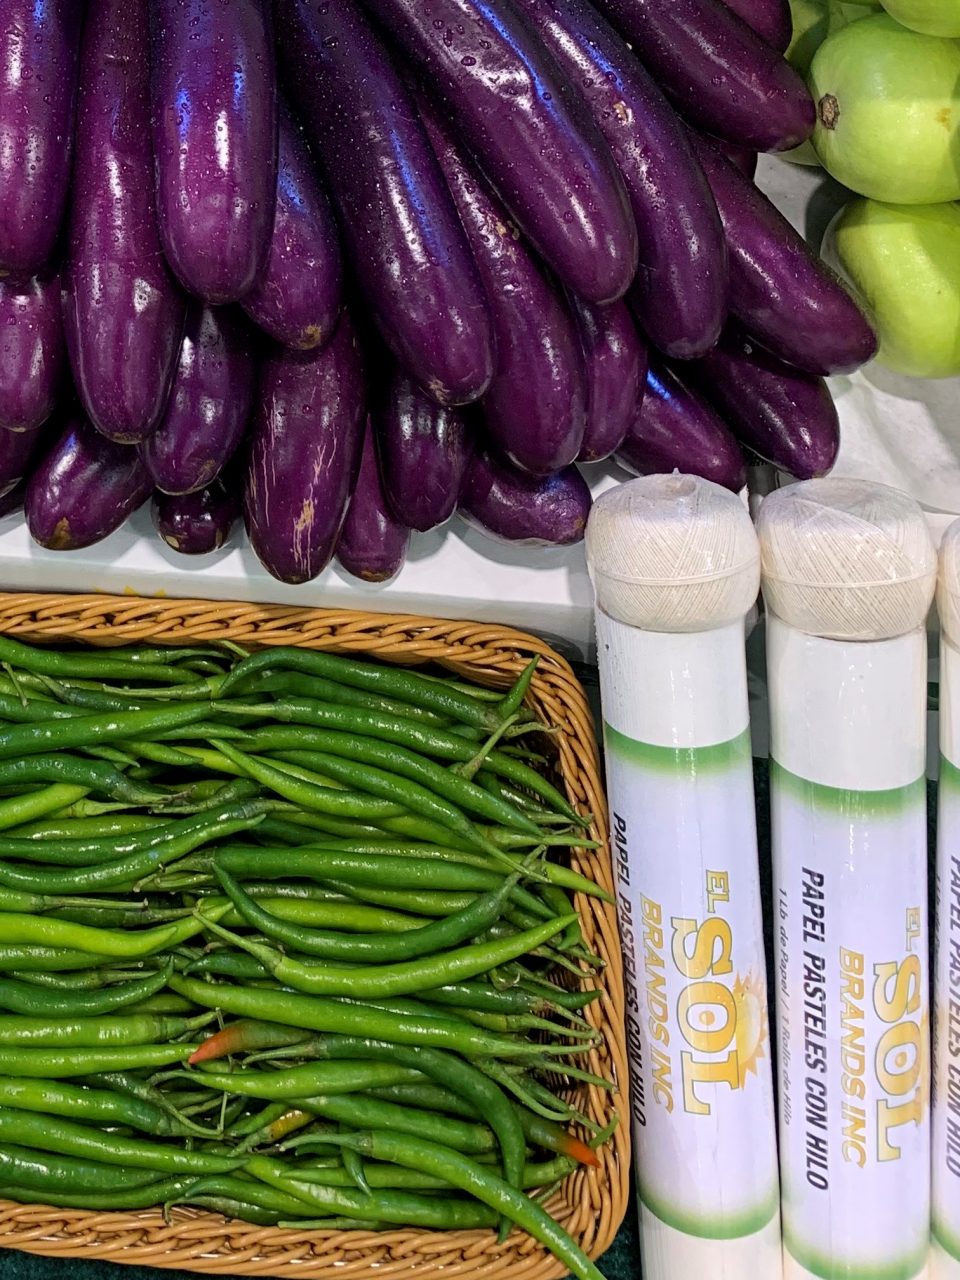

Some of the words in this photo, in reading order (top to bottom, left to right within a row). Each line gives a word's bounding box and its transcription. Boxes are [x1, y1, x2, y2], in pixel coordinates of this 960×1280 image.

[613, 811, 630, 887] PAPEL
[705, 869, 730, 913] EL
[778, 899, 788, 920] Lb
[802, 866, 825, 948] PAPEL
[618, 891, 639, 1017] PASTELES
[779, 926, 789, 946] de
[905, 906, 921, 951] EL
[640, 891, 670, 1047] BRANDS
[778, 948, 790, 997] Papel
[670, 916, 740, 1116] SOL
[802, 952, 827, 1074] PASTELES
[839, 945, 867, 1100] BRANDS
[626, 1019, 642, 1073] CON
[781, 1029, 791, 1069] Rollo
[872, 954, 921, 1162] SOL
[630, 1073, 646, 1127] HILO
[650, 1047, 674, 1115] INC
[782, 1070, 792, 1091] de
[783, 1092, 792, 1126] Hilo
[805, 1076, 829, 1130] CON
[805, 1131, 829, 1191] HILO
[841, 1100, 868, 1169] INC
